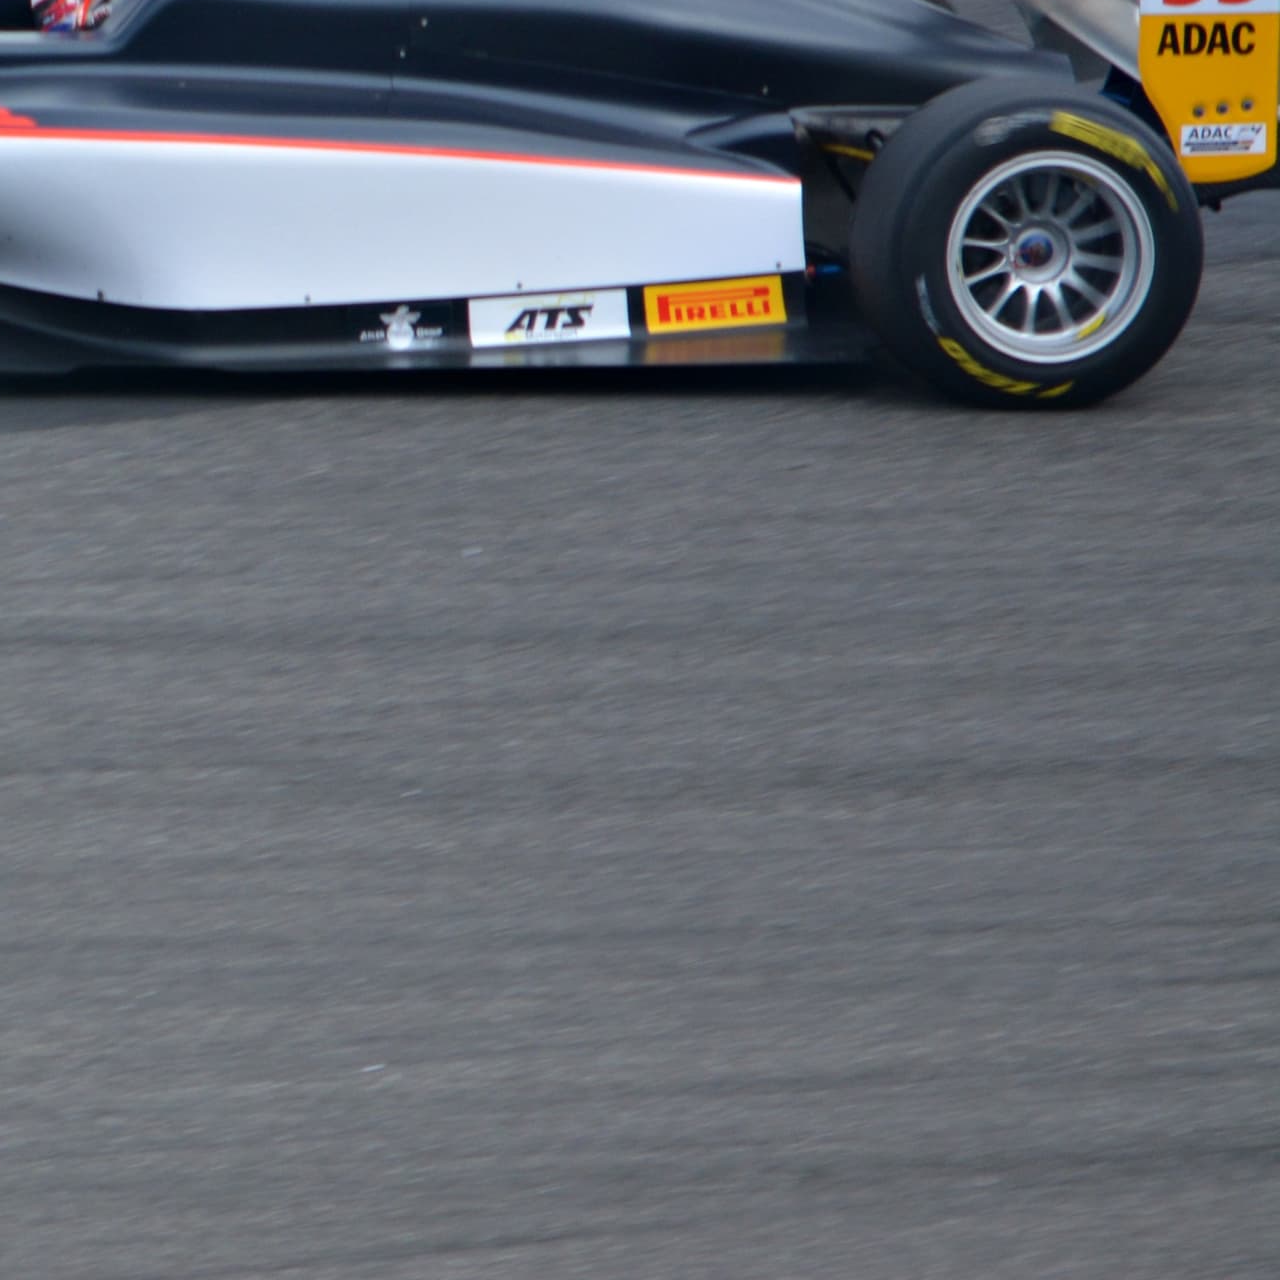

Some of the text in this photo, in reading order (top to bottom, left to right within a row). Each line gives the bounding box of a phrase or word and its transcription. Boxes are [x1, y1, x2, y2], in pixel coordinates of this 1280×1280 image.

[1157, 21, 1256, 56] ADAC
[1189, 125, 1233, 139] ADAC
[506, 303, 594, 333] ATS
[657, 285, 770, 323] PIRELLI
